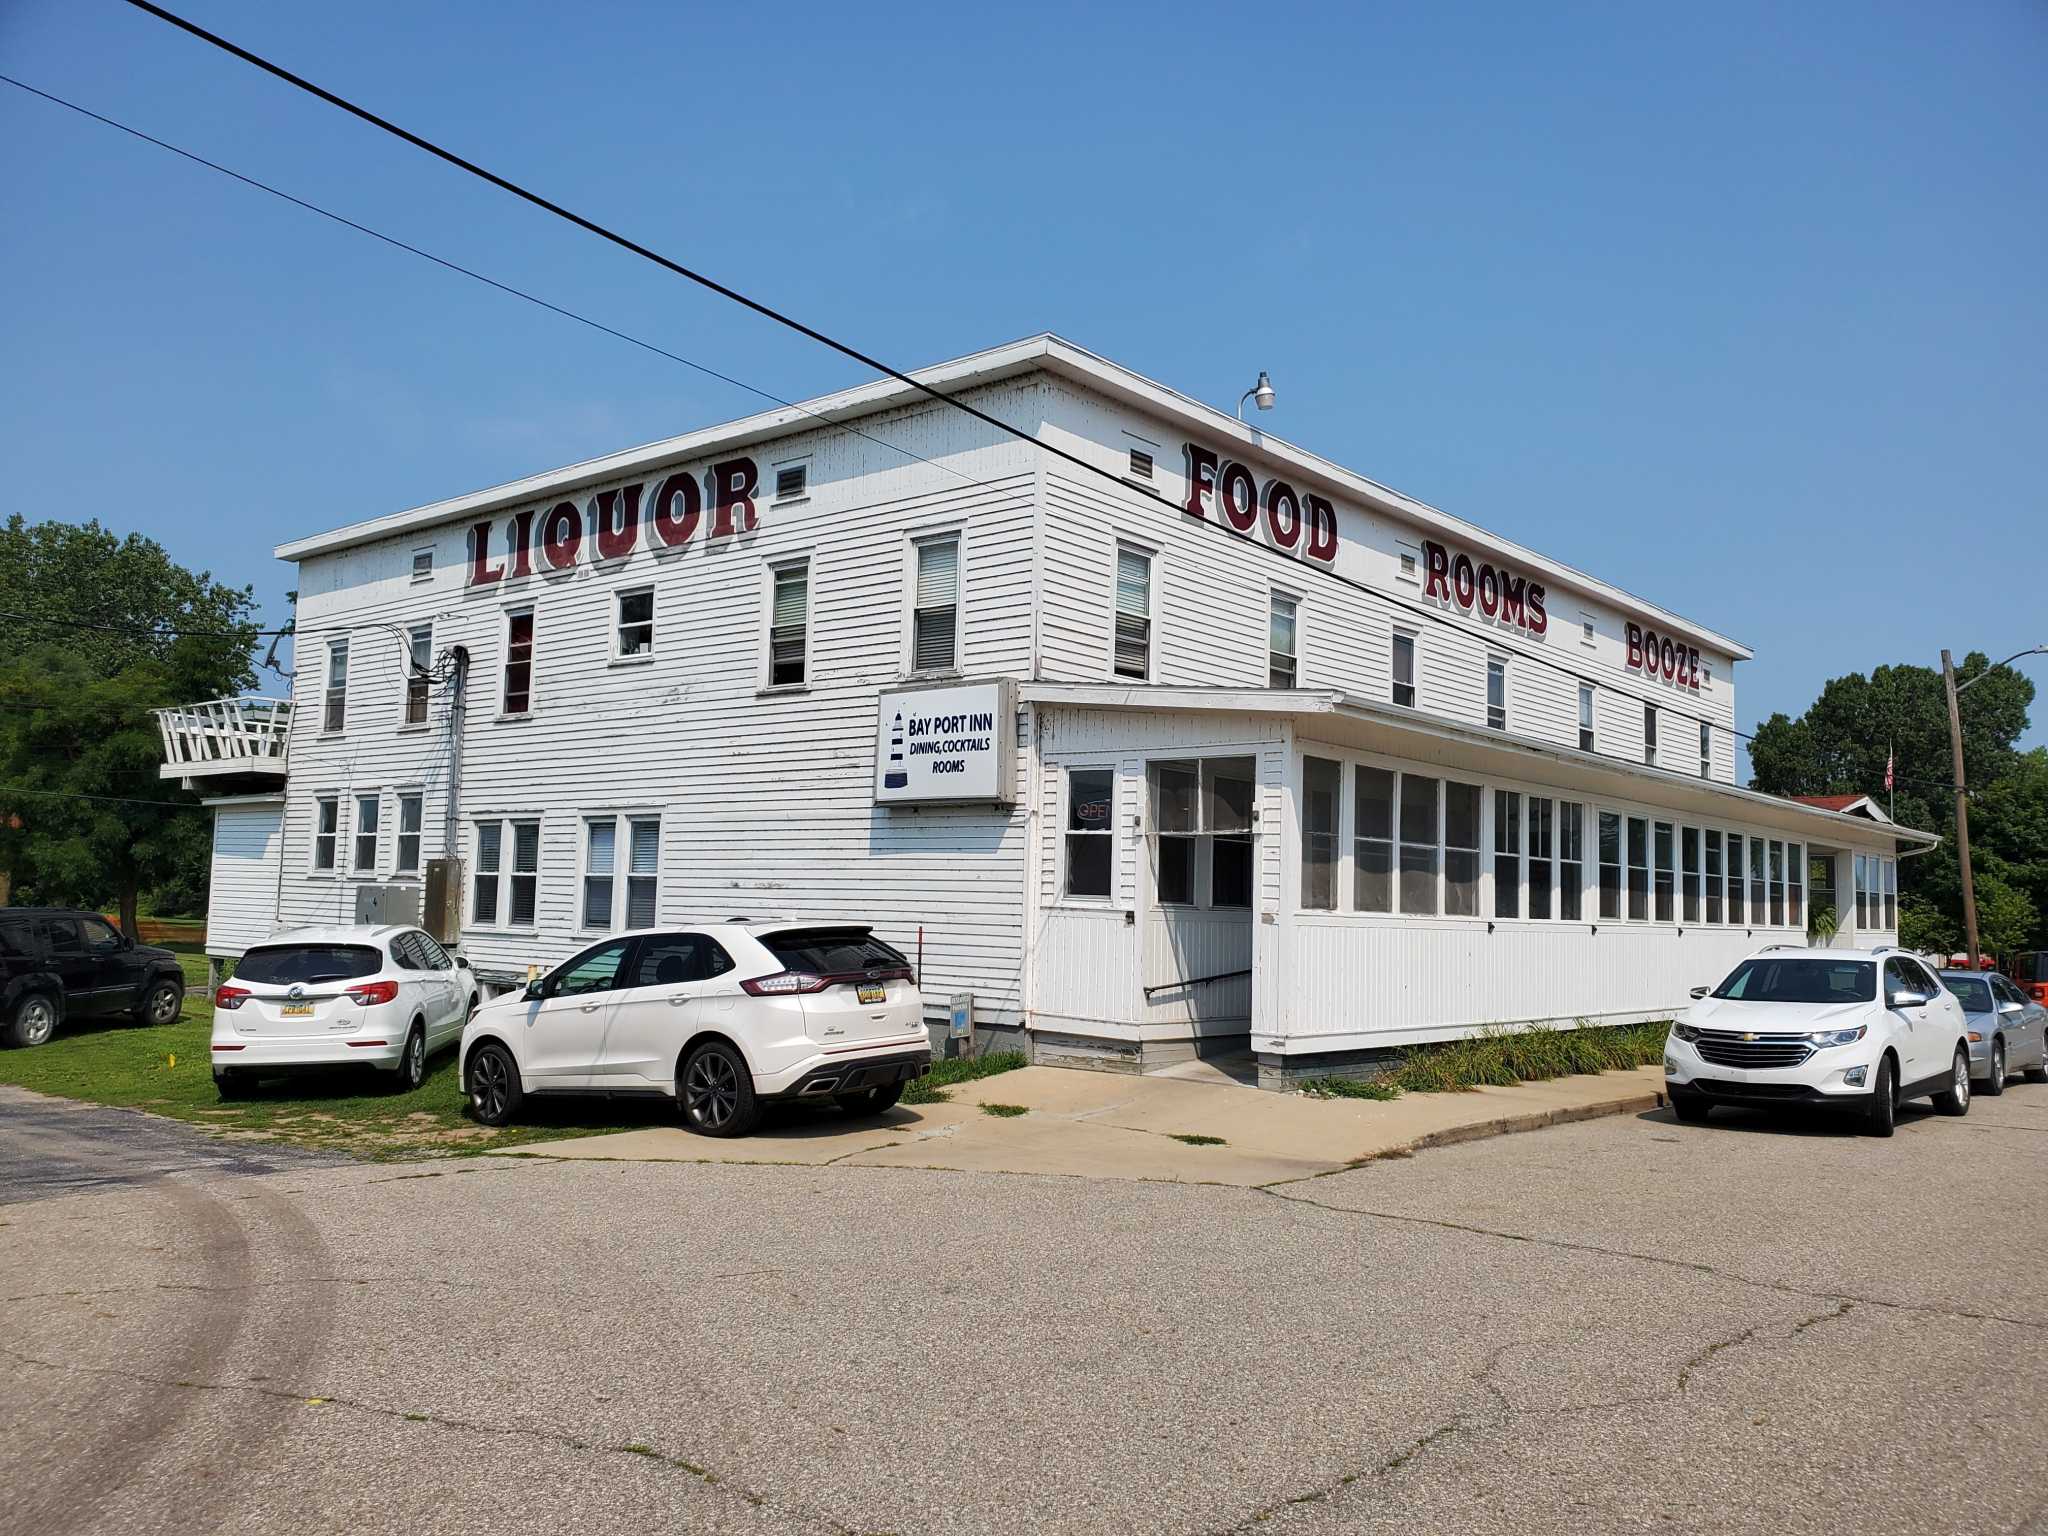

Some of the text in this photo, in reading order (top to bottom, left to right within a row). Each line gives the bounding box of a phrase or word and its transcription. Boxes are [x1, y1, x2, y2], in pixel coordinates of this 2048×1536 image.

[467, 457, 760, 592] LIQUOR
[1182, 442, 1338, 565] FOOD
[1422, 539, 1548, 640] ROOMS
[1625, 622, 1700, 694] BOOZE
[908, 713, 993, 736] BAY PORT INN
[932, 760, 965, 773] ROOMS
